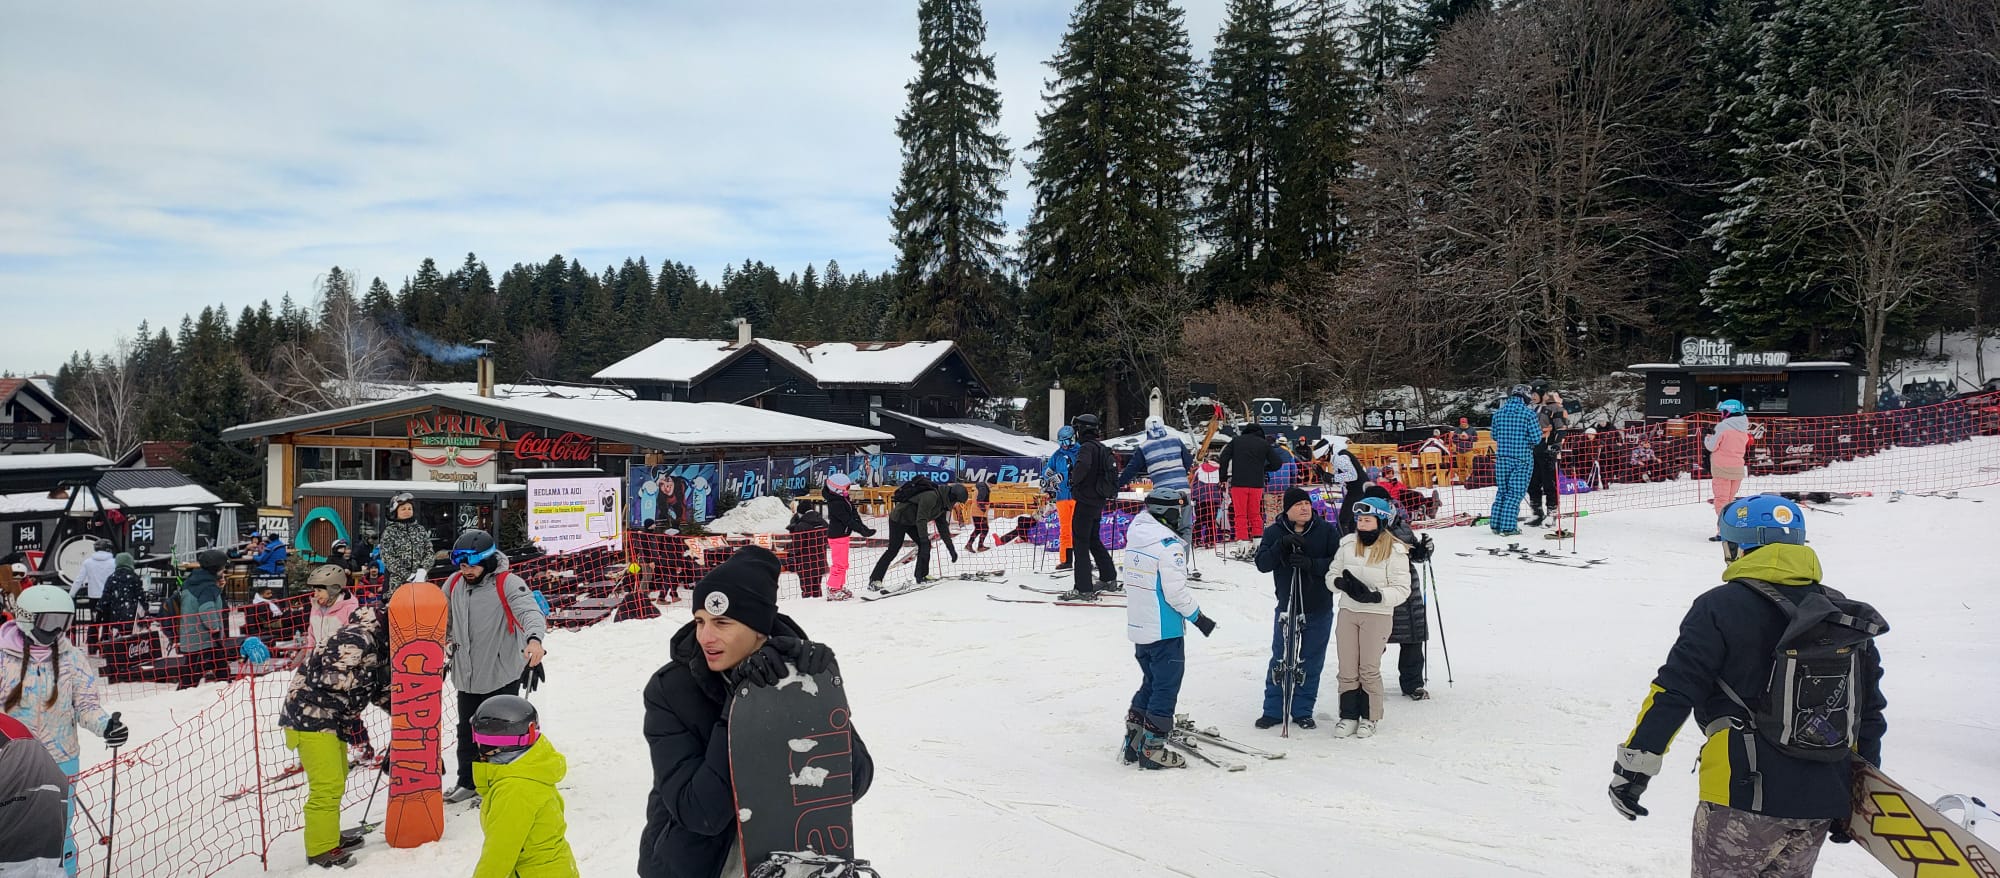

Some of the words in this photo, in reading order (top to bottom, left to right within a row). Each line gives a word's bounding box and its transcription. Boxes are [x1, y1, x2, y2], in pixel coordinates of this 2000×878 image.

[1712, 355, 1731, 366] Ski
[1762, 352, 1788, 367] FOOD
[405, 415, 511, 441] PAPRIKA
[421, 436, 482, 447] RESTAURANT
[964, 464, 1039, 486] MrBit
[258, 516, 290, 531] PIZZA
[14, 542, 41, 551] rental
